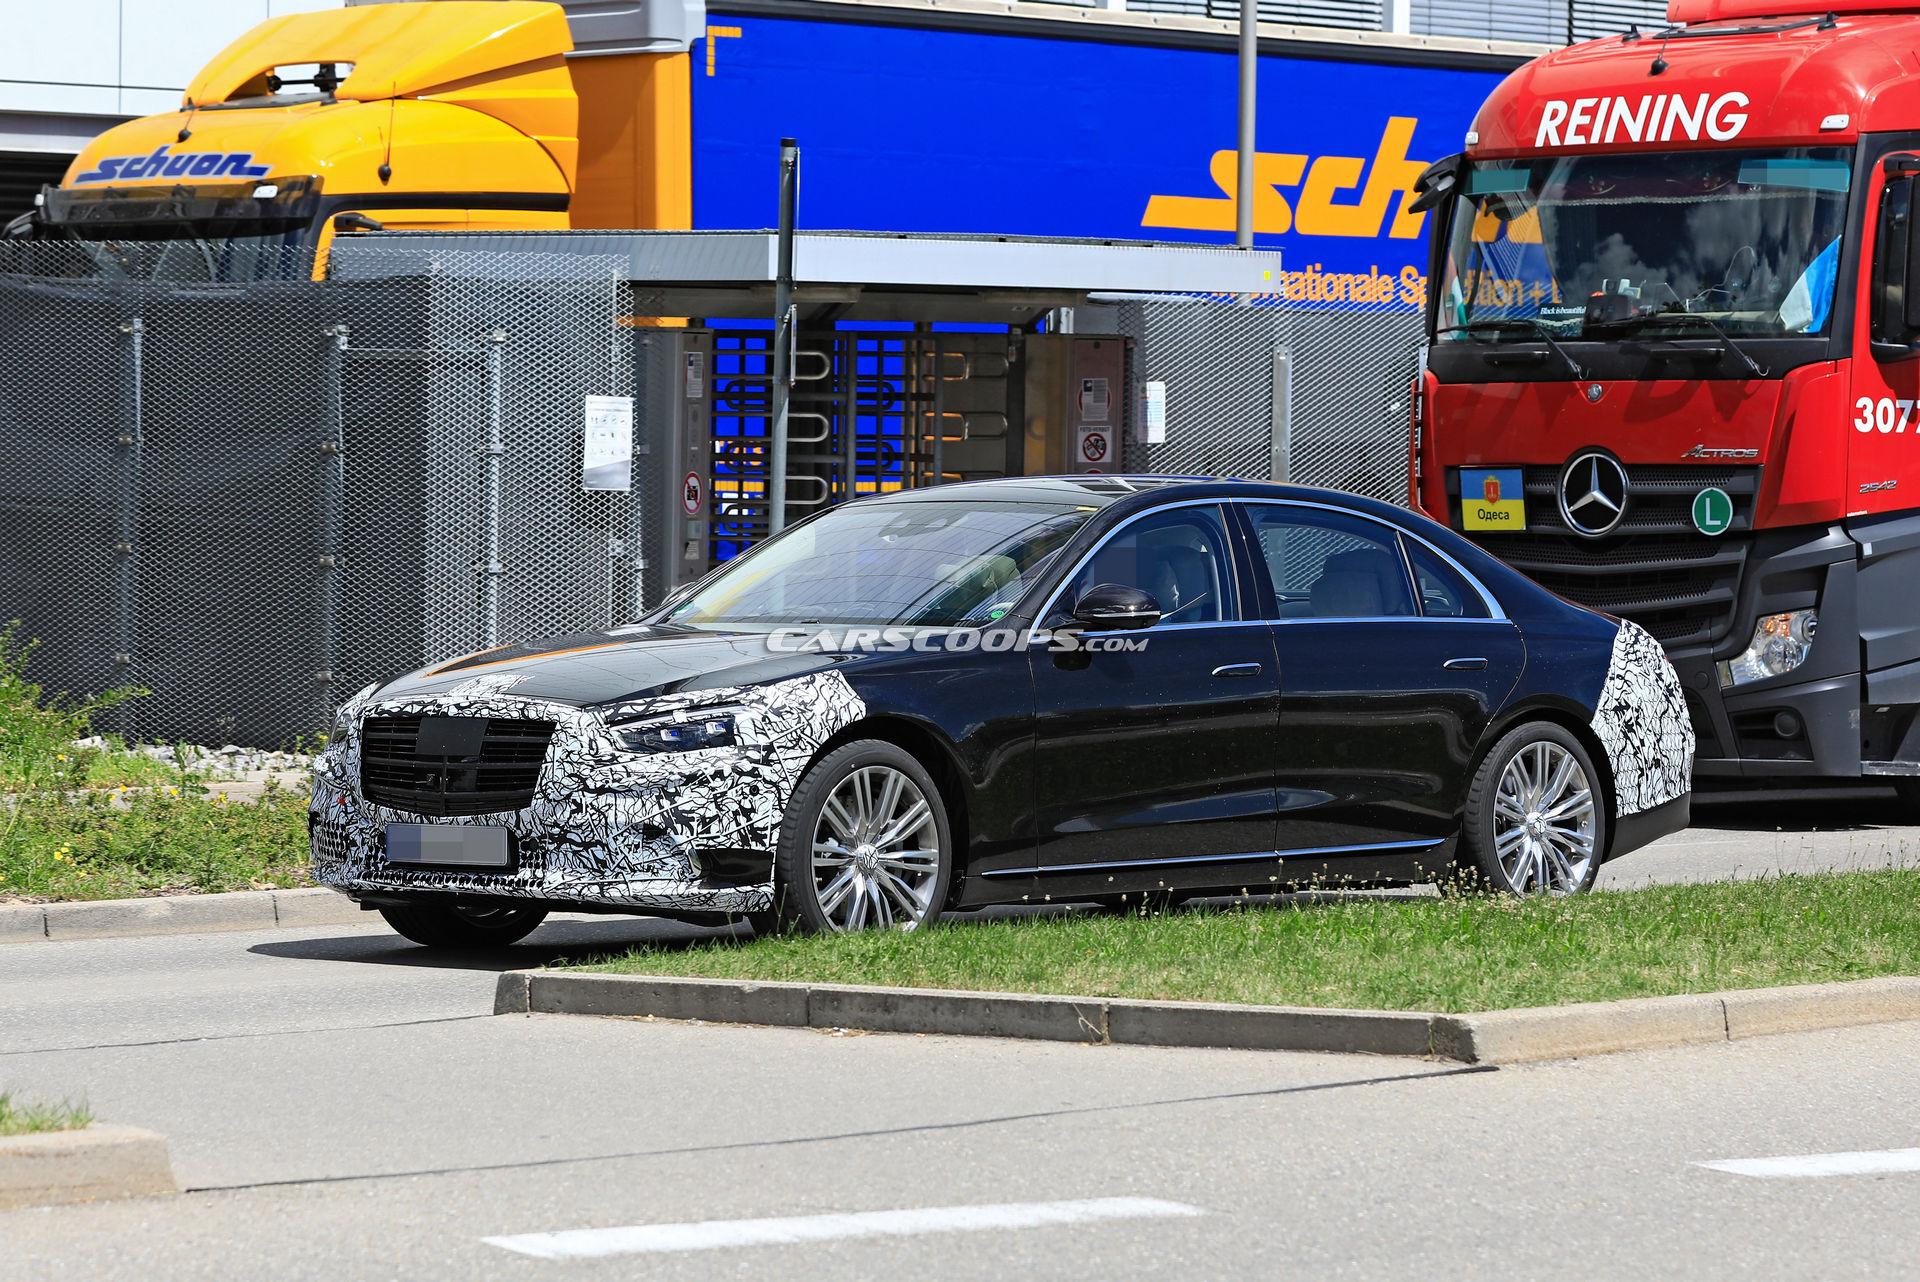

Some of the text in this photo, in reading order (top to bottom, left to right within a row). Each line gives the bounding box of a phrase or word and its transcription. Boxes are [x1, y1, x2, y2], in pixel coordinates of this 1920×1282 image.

[1534, 91, 1750, 148] REINING
[73, 143, 274, 184] schuon
[1140, 116, 1542, 243] sch
[1853, 396, 1920, 434] 307
[1681, 444, 1759, 459] ACTROS
[1859, 479, 1898, 494] 2542
[1477, 508, 1510, 523] Одеса
[1705, 497, 1721, 526] L
